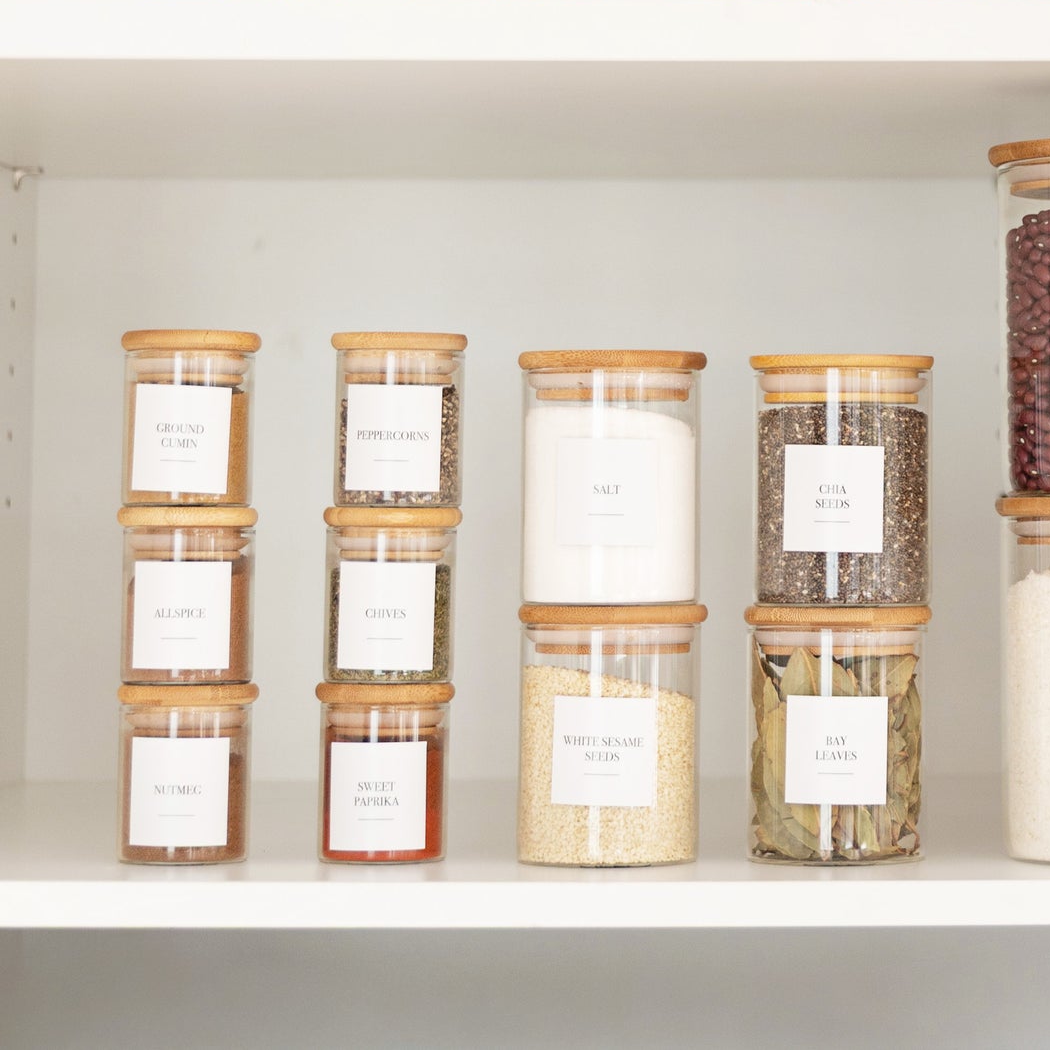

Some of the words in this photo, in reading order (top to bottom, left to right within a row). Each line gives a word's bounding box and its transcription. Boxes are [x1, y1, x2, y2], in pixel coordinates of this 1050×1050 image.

[156, 422, 205, 435] GROUND
[356, 429, 431, 441] PEPPERCORNS
[160, 437, 198, 449] CUMIN
[593, 484, 621, 495] SALT
[818, 484, 847, 495] CHIA
[815, 498, 850, 510] SEEDS
[154, 607, 206, 619] ALLSPICE
[365, 607, 407, 619] CHIVES
[563, 735, 599, 747] WHITE
[601, 735, 644, 748] SESAME
[826, 735, 848, 746] BAY
[584, 750, 620, 762] SEEDS
[815, 749, 858, 761] LEAVES
[153, 784, 202, 796] NUTMEG
[357, 781, 396, 792] SWEET
[353, 796, 400, 807] PAPRIKA
